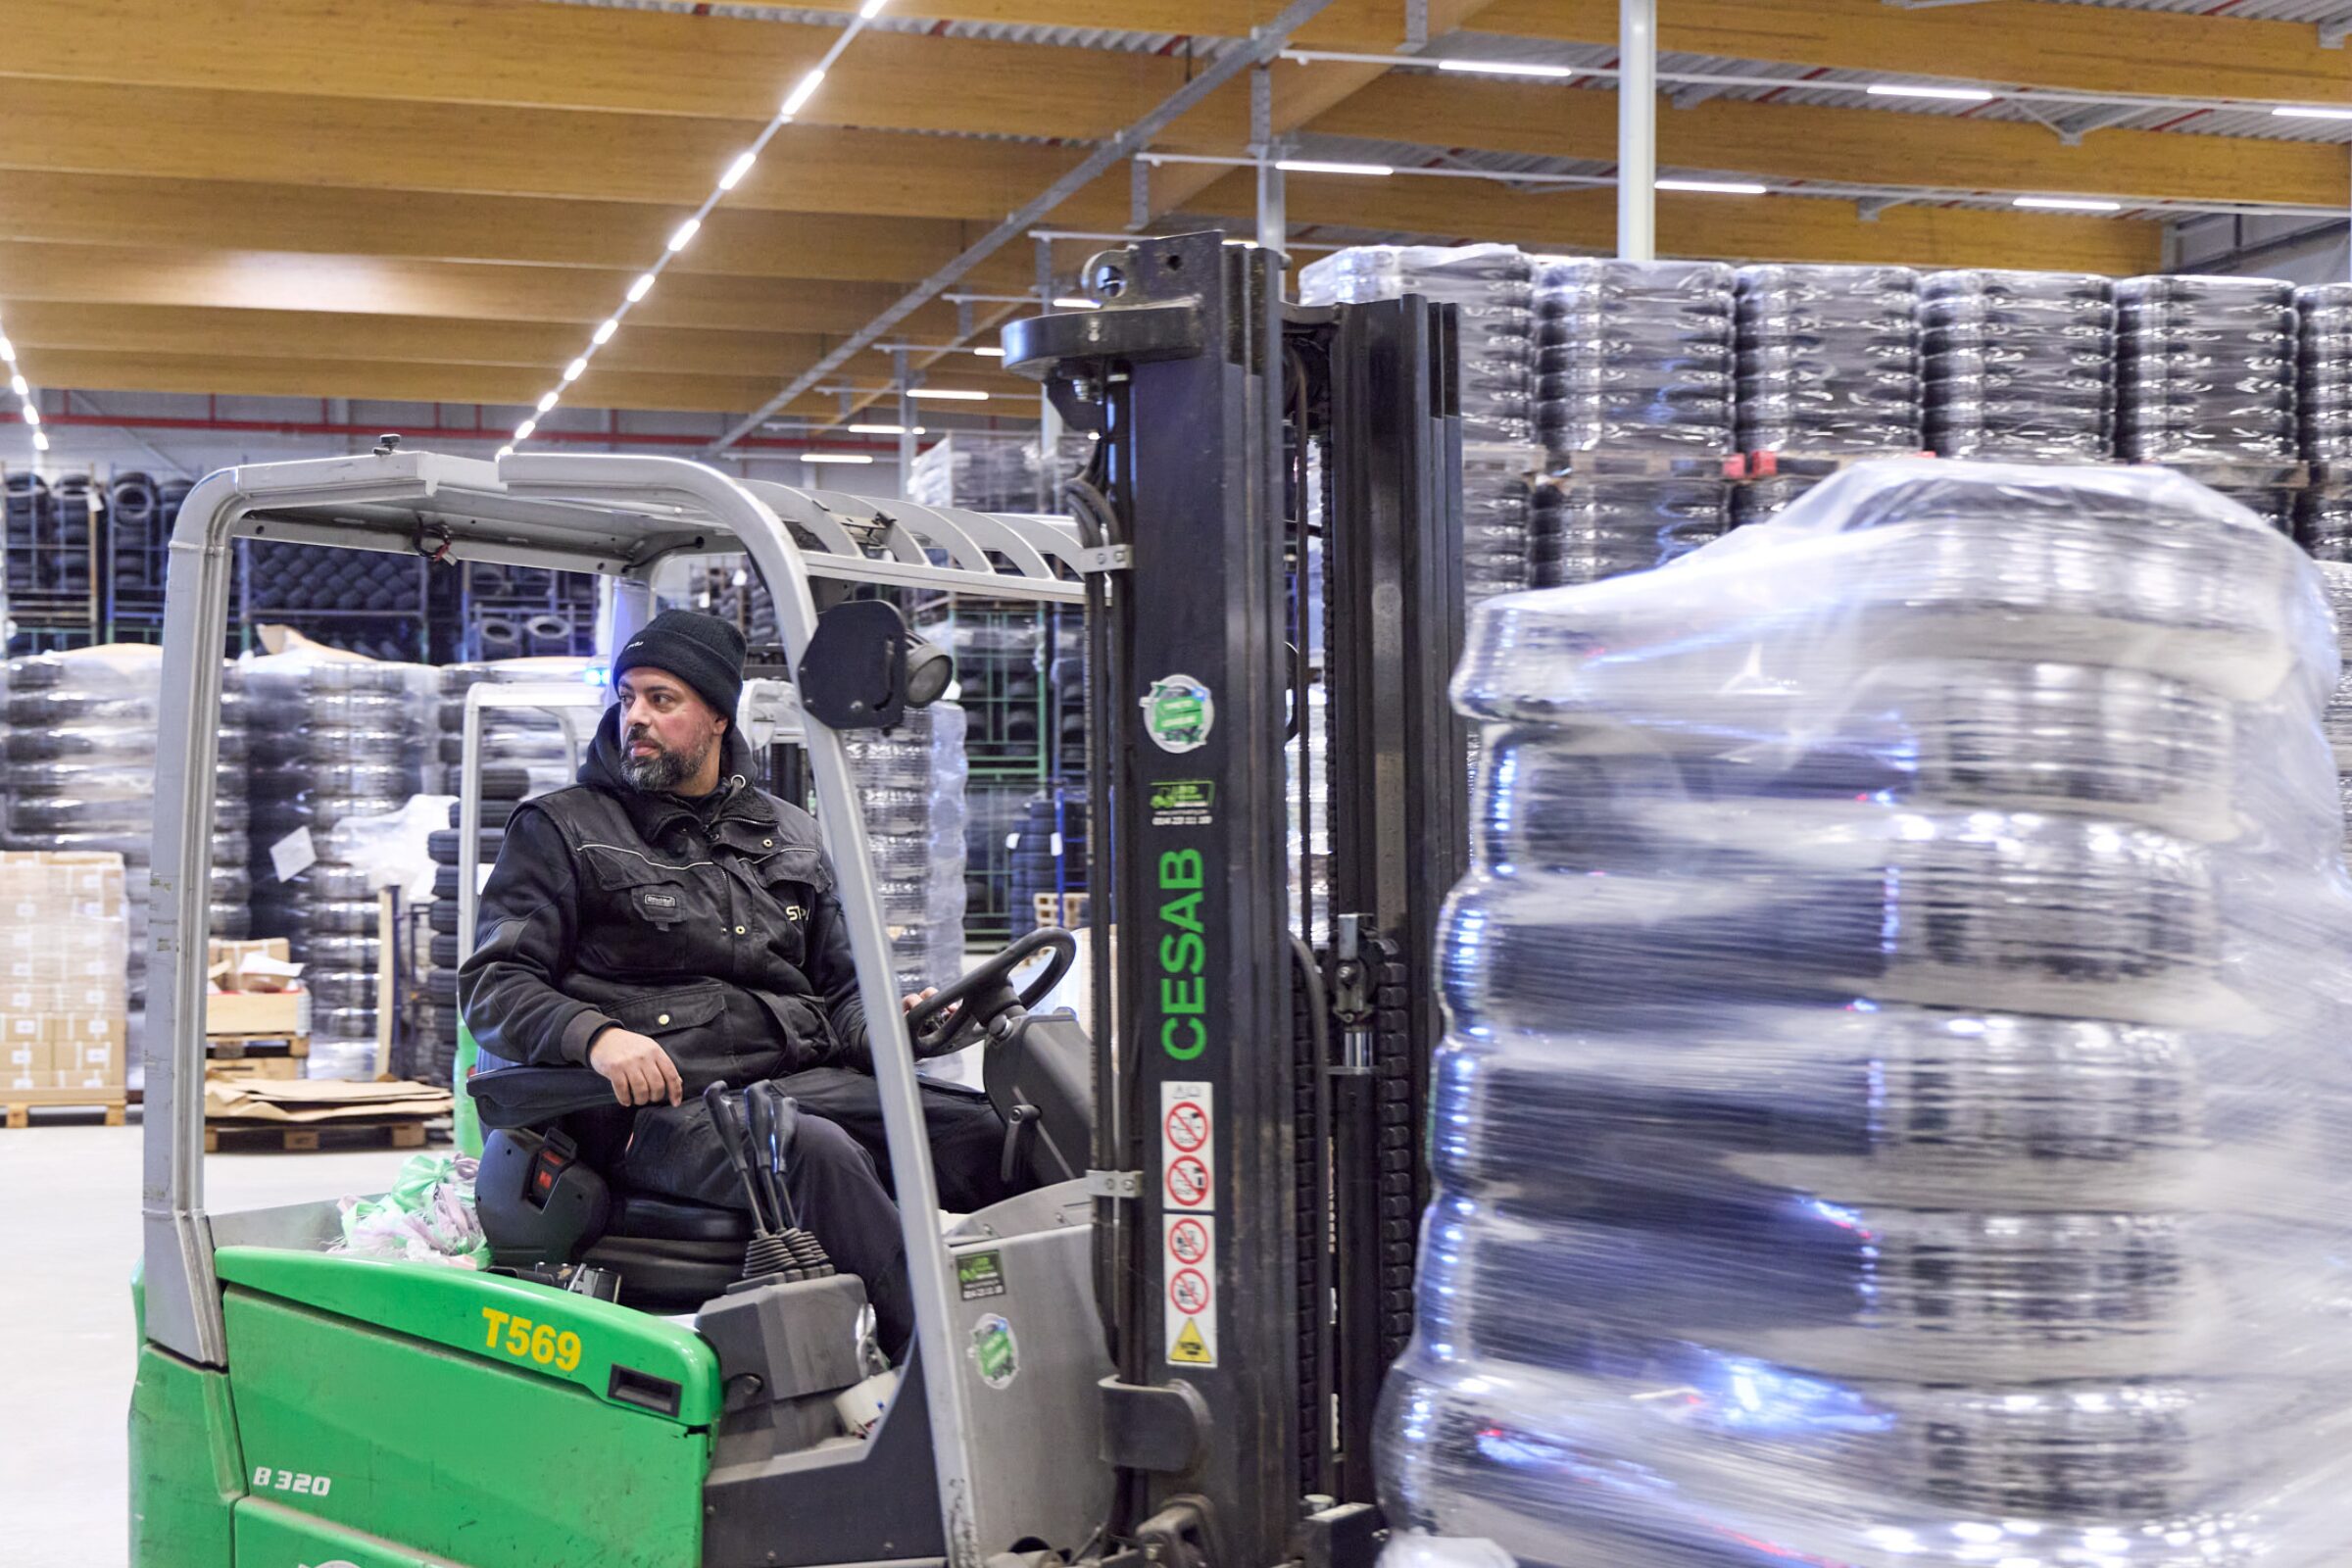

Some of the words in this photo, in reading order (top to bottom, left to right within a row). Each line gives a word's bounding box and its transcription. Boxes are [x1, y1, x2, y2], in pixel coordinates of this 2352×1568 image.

[1159, 848, 1207, 1060] CESAB
[481, 1306, 582, 1372] T569
[253, 1466, 272, 1487] B
[274, 1469, 331, 1496] 320
